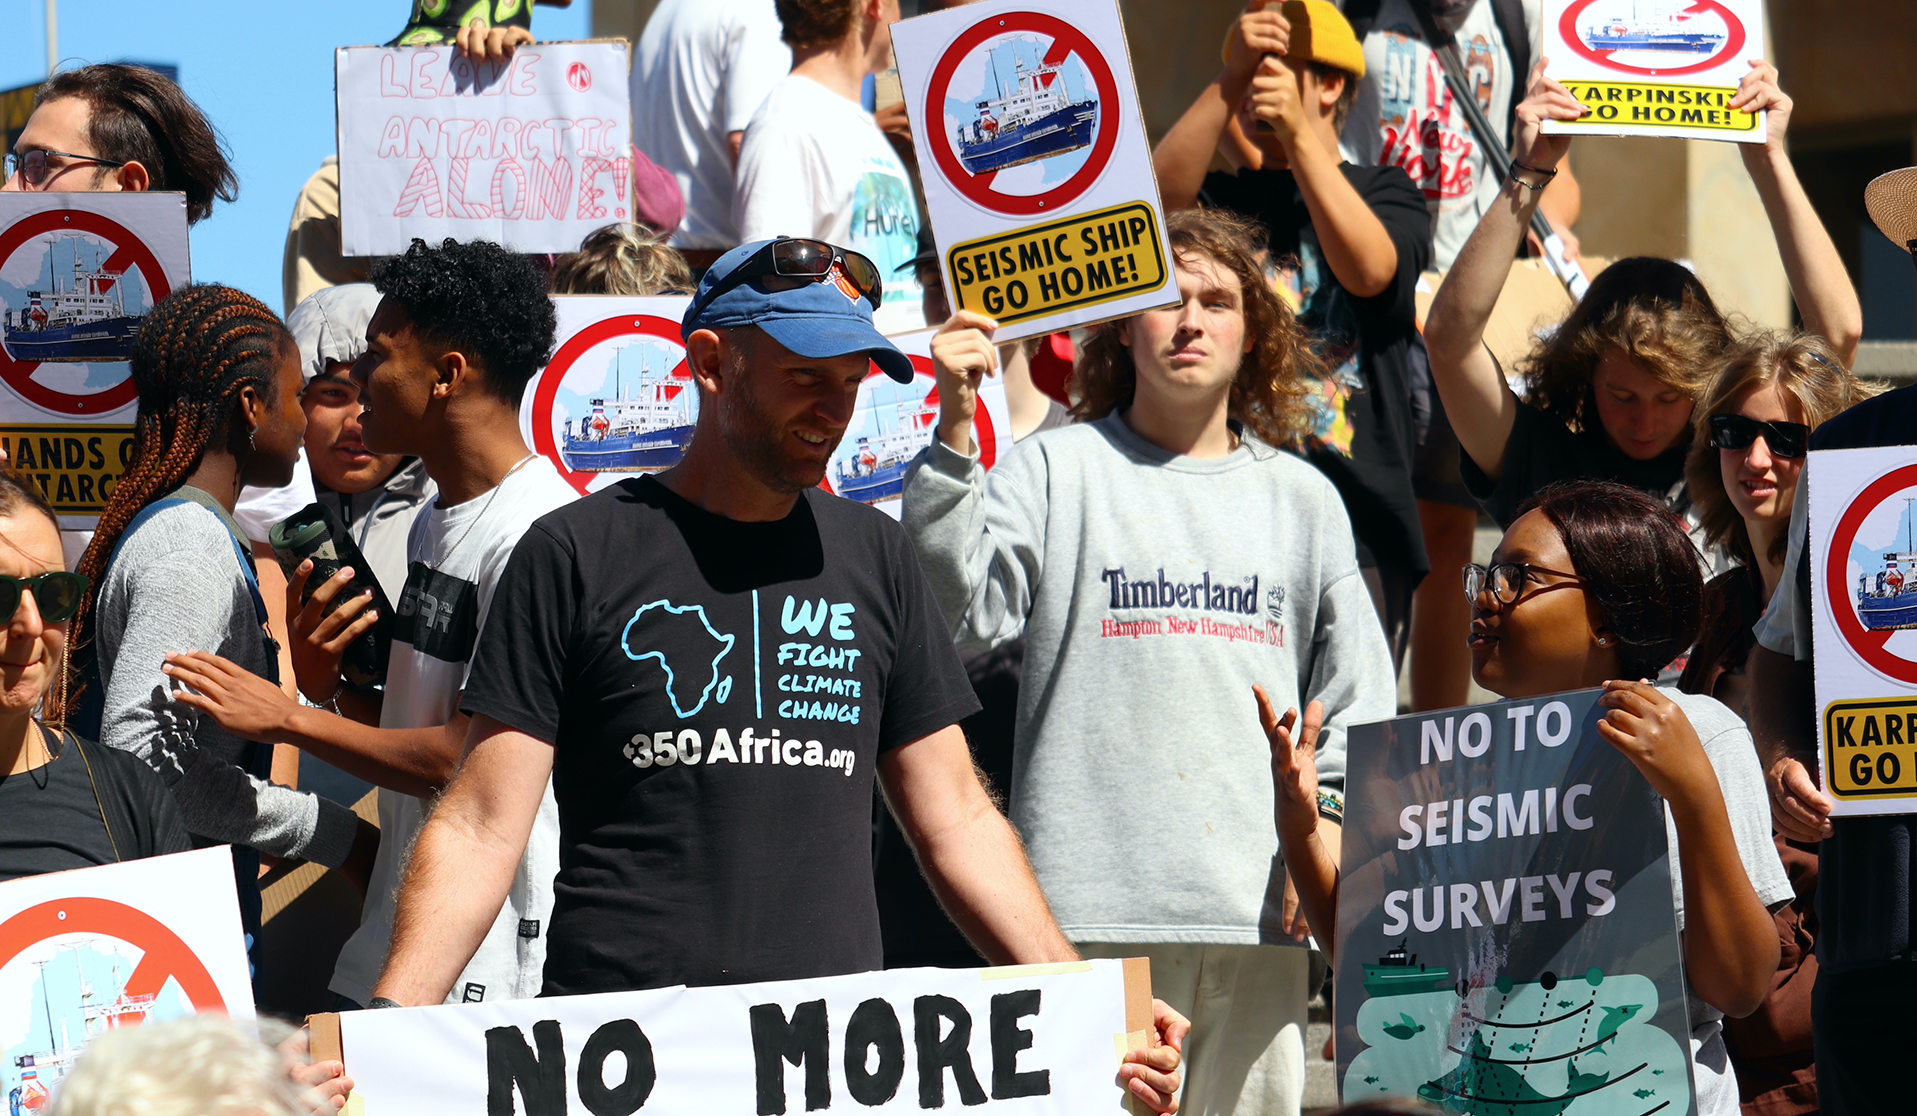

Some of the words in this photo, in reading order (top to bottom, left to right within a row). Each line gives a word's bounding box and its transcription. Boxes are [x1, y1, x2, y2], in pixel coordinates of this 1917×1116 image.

[380, 50, 541, 99] LEAVE
[378, 116, 617, 161] ANTARCTIC
[1632, 106, 1732, 126] HOME!
[393, 156, 630, 221] ALONE!
[957, 233, 1072, 286] SEISMIC
[1080, 217, 1146, 256] SHIP
[982, 279, 1029, 315] GO
[1038, 253, 1139, 303] HOME!
[1101, 567, 1258, 616] Timberland
[781, 595, 856, 641] WE
[1165, 616, 1199, 636] New
[1200, 618, 1265, 645] Hampshire
[1265, 621, 1285, 649] USA
[777, 642, 862, 672] FIGHT
[777, 674, 862, 699] CLIMATE
[778, 699, 861, 725] CHANGE
[1420, 712, 1493, 765] NO
[1507, 701, 1572, 752] TO
[1849, 752, 1901, 786] GO
[1397, 783, 1594, 850] SEISMIC
[1383, 869, 1617, 936] SURVEYS
[485, 1018, 657, 1116] NO
[749, 989, 1052, 1116] MORE
